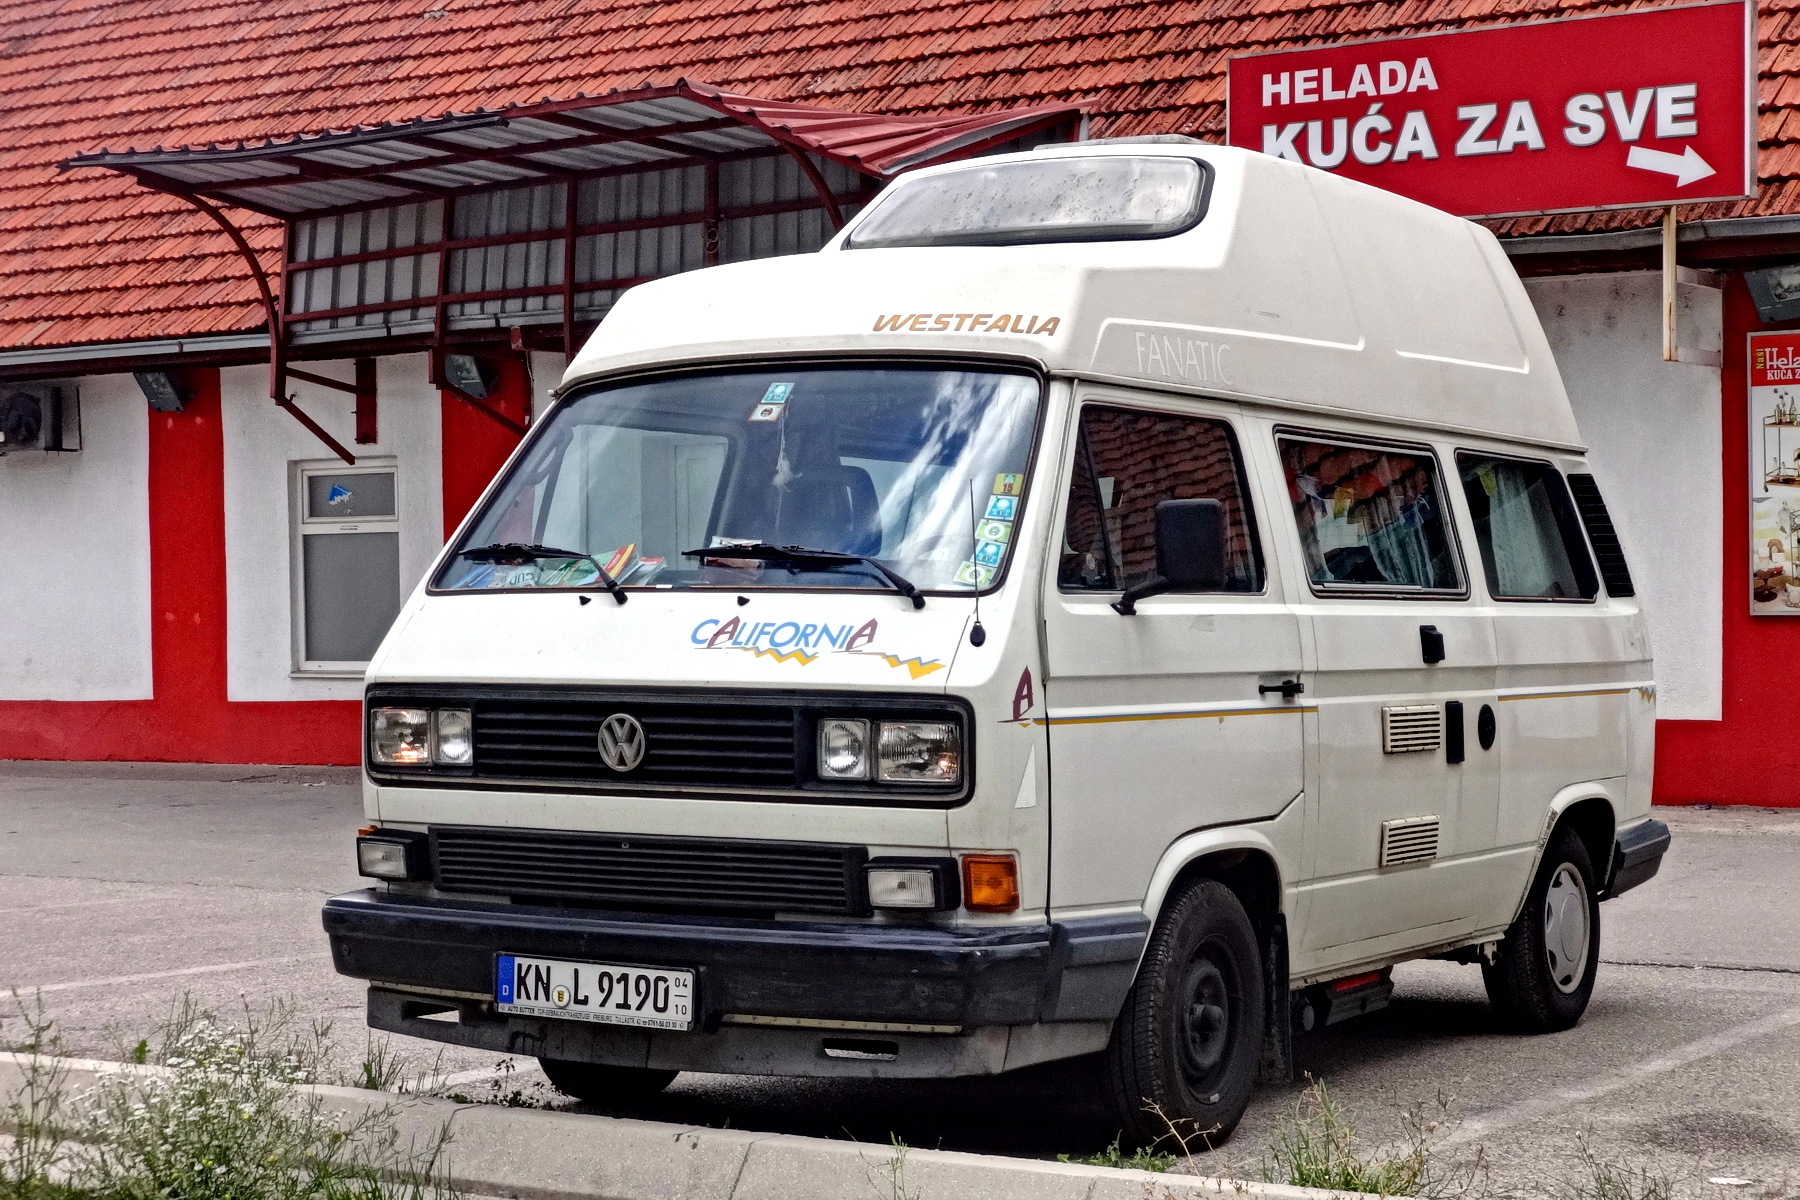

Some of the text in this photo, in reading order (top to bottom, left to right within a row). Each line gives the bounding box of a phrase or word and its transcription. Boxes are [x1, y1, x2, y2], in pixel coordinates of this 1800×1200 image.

[1262, 57, 1439, 107] HELADA
[1262, 83, 1698, 169] KUĆA ZA SVE
[872, 313, 1061, 337] WESTFALIA
[1135, 331, 1234, 386] FANATIC
[691, 615, 878, 651] CALIFORNIA
[502, 985, 509, 996] D
[516, 962, 670, 1013] KN L 9190
[674, 977, 688, 988] 04
[674, 1004, 688, 1015] 10
